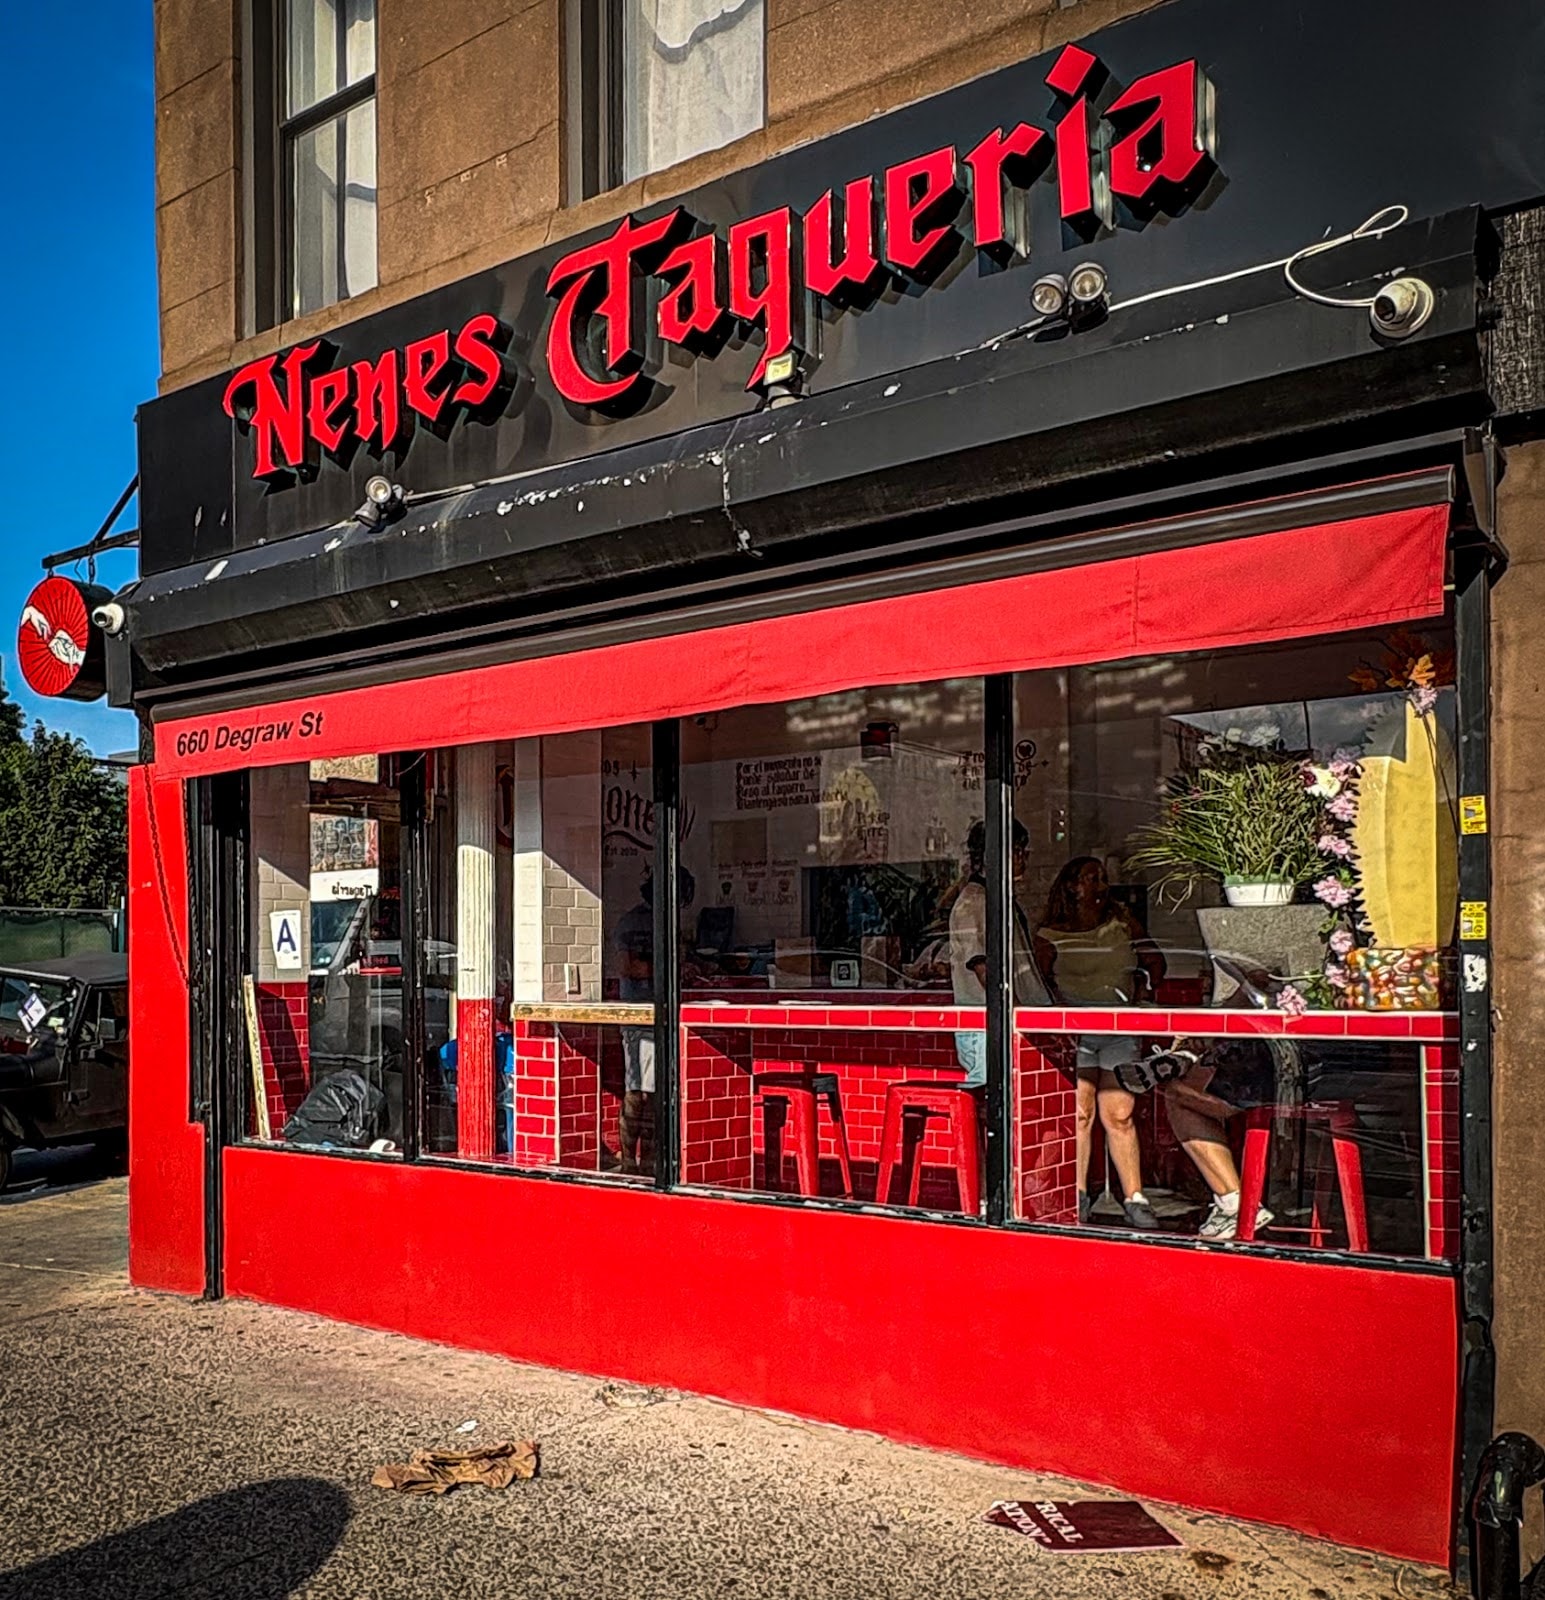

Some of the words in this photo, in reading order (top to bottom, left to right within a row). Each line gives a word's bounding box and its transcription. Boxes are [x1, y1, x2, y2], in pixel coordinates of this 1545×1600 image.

[222, 312, 502, 479] Nenes
[546, 43, 1206, 403] Taqueria
[177, 729, 209, 756] 660
[214, 721, 294, 751] Degraw
[298, 711, 324, 737] St
[277, 918, 297, 952] A
[1036, 1500, 1084, 1543] RICAL
